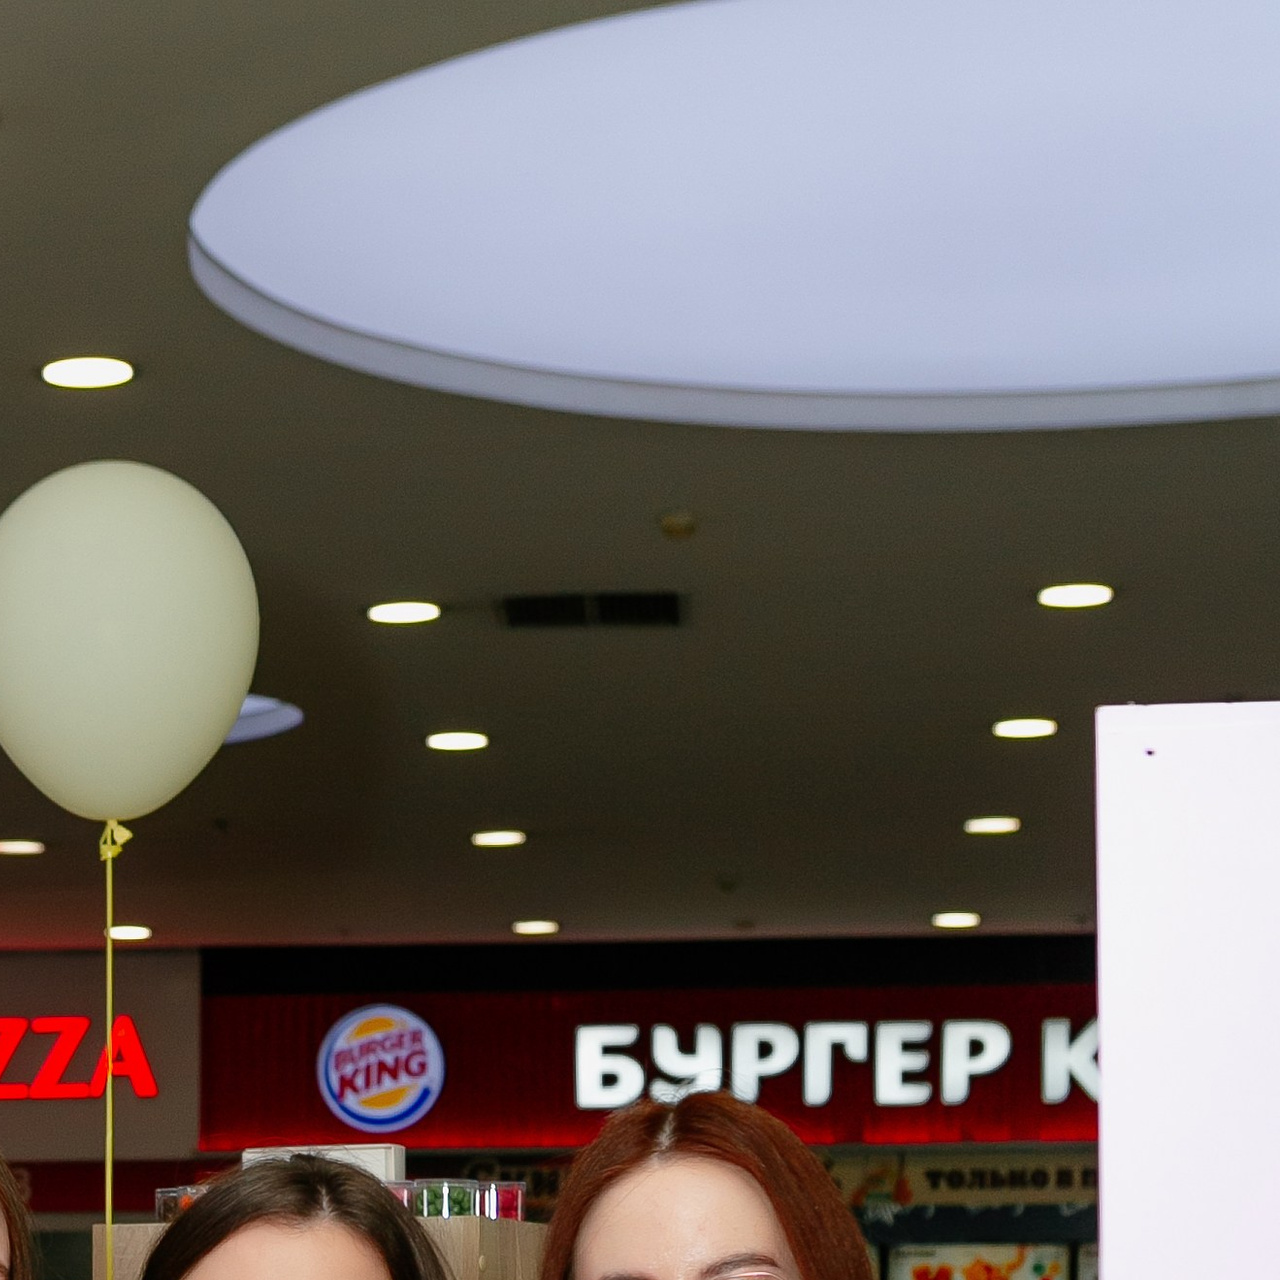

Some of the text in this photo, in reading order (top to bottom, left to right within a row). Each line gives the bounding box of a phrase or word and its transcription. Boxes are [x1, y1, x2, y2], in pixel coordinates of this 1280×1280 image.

[334, 1027, 423, 1073] BURGER
[574, 1019, 1012, 1109] БУРГЕР
[337, 1049, 427, 1103] KING
[925, 1167, 1050, 1190] ТОЛЬКО
